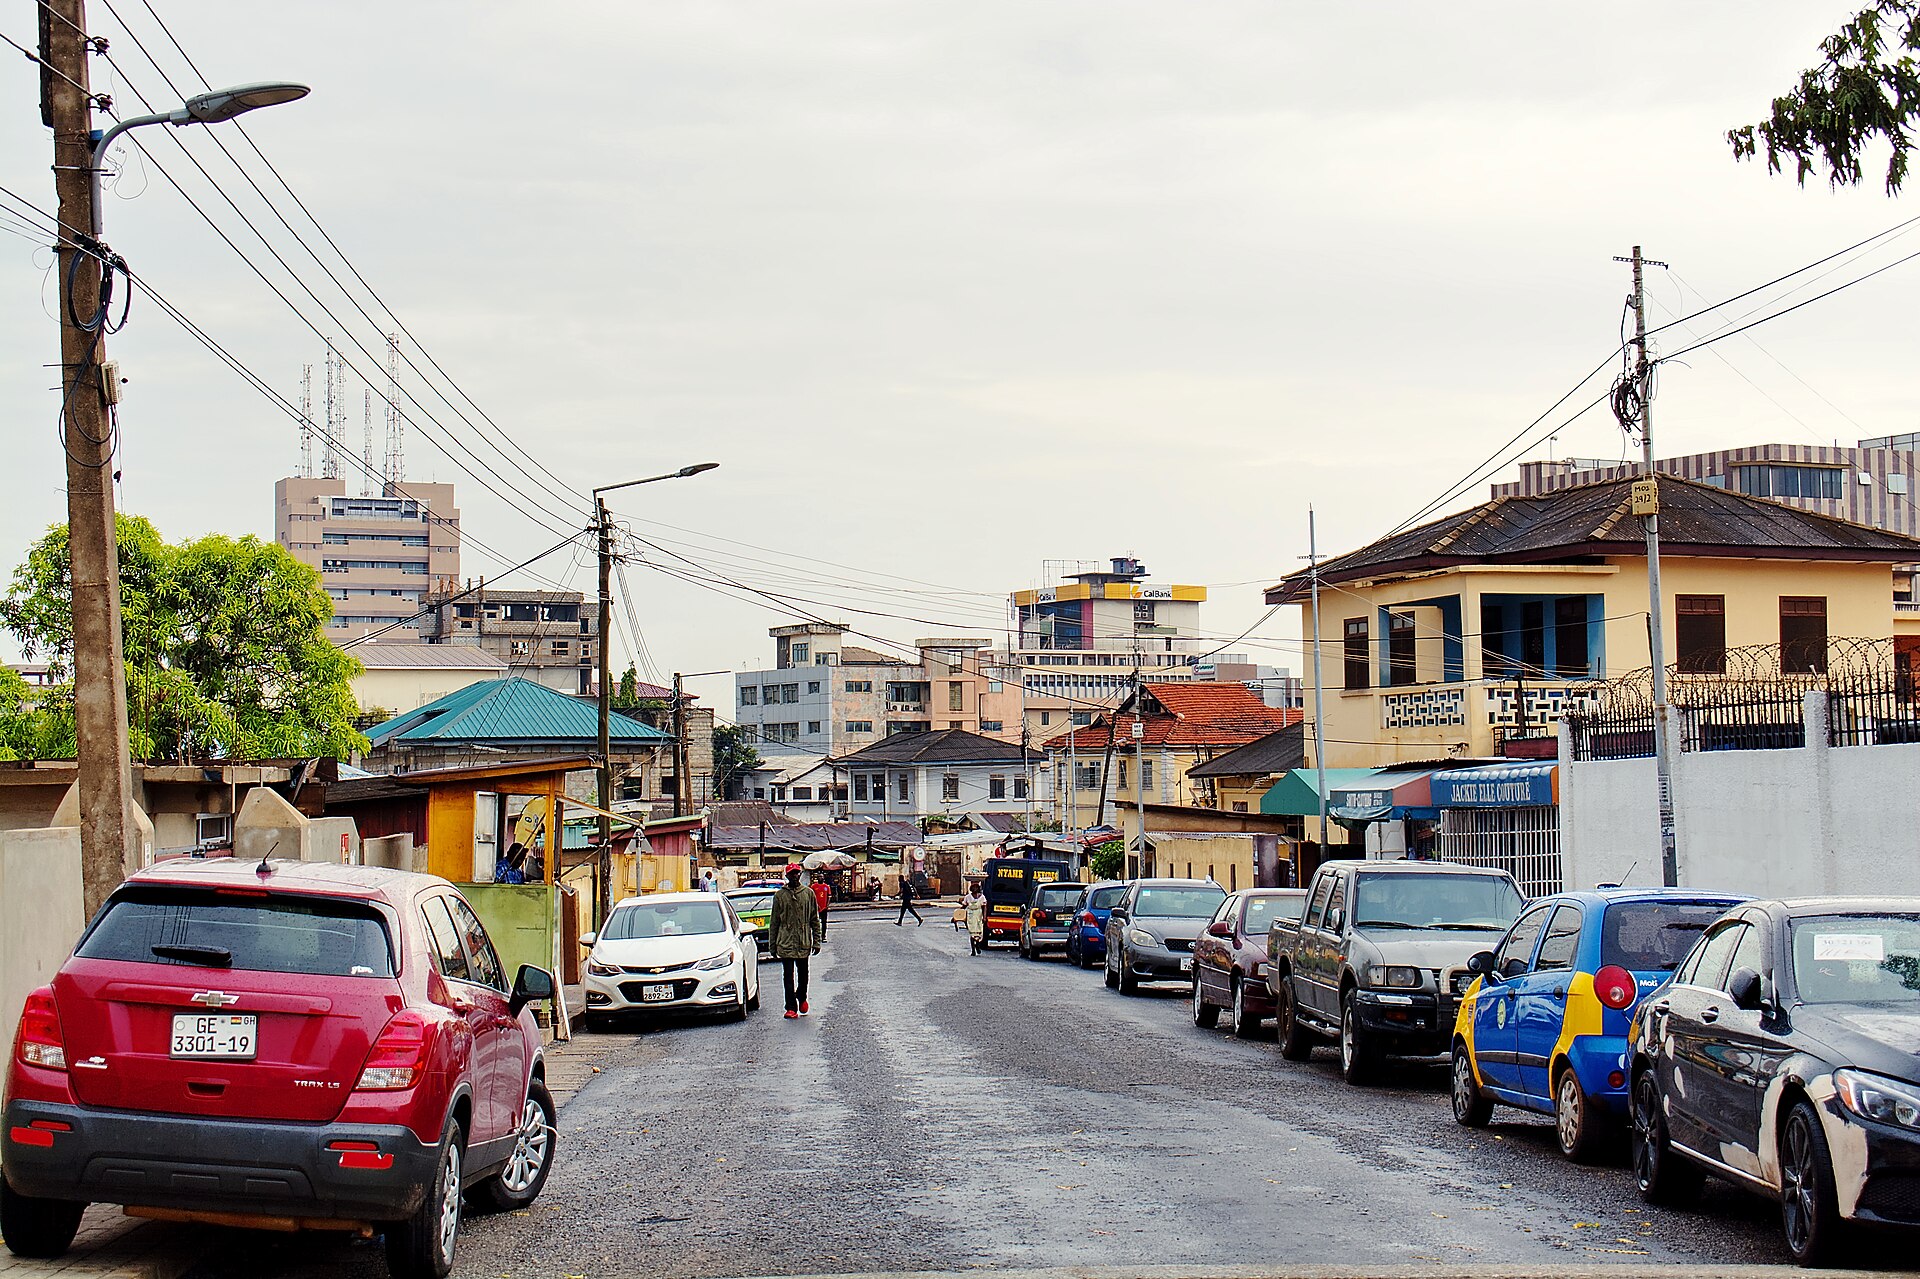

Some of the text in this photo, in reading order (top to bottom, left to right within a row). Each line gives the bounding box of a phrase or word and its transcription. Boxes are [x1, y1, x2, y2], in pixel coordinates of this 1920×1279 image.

[1143, 590, 1172, 599] CalBank
[1450, 784, 1478, 802] JACKIE
[1478, 783, 1496, 803] ELLE
[997, 868, 1024, 879] NYAME
[196, 1017, 218, 1034] GE
[243, 1016, 256, 1026] GH
[173, 1035, 250, 1053] 3301-19
[294, 1079, 341, 1089] TRAX LS
